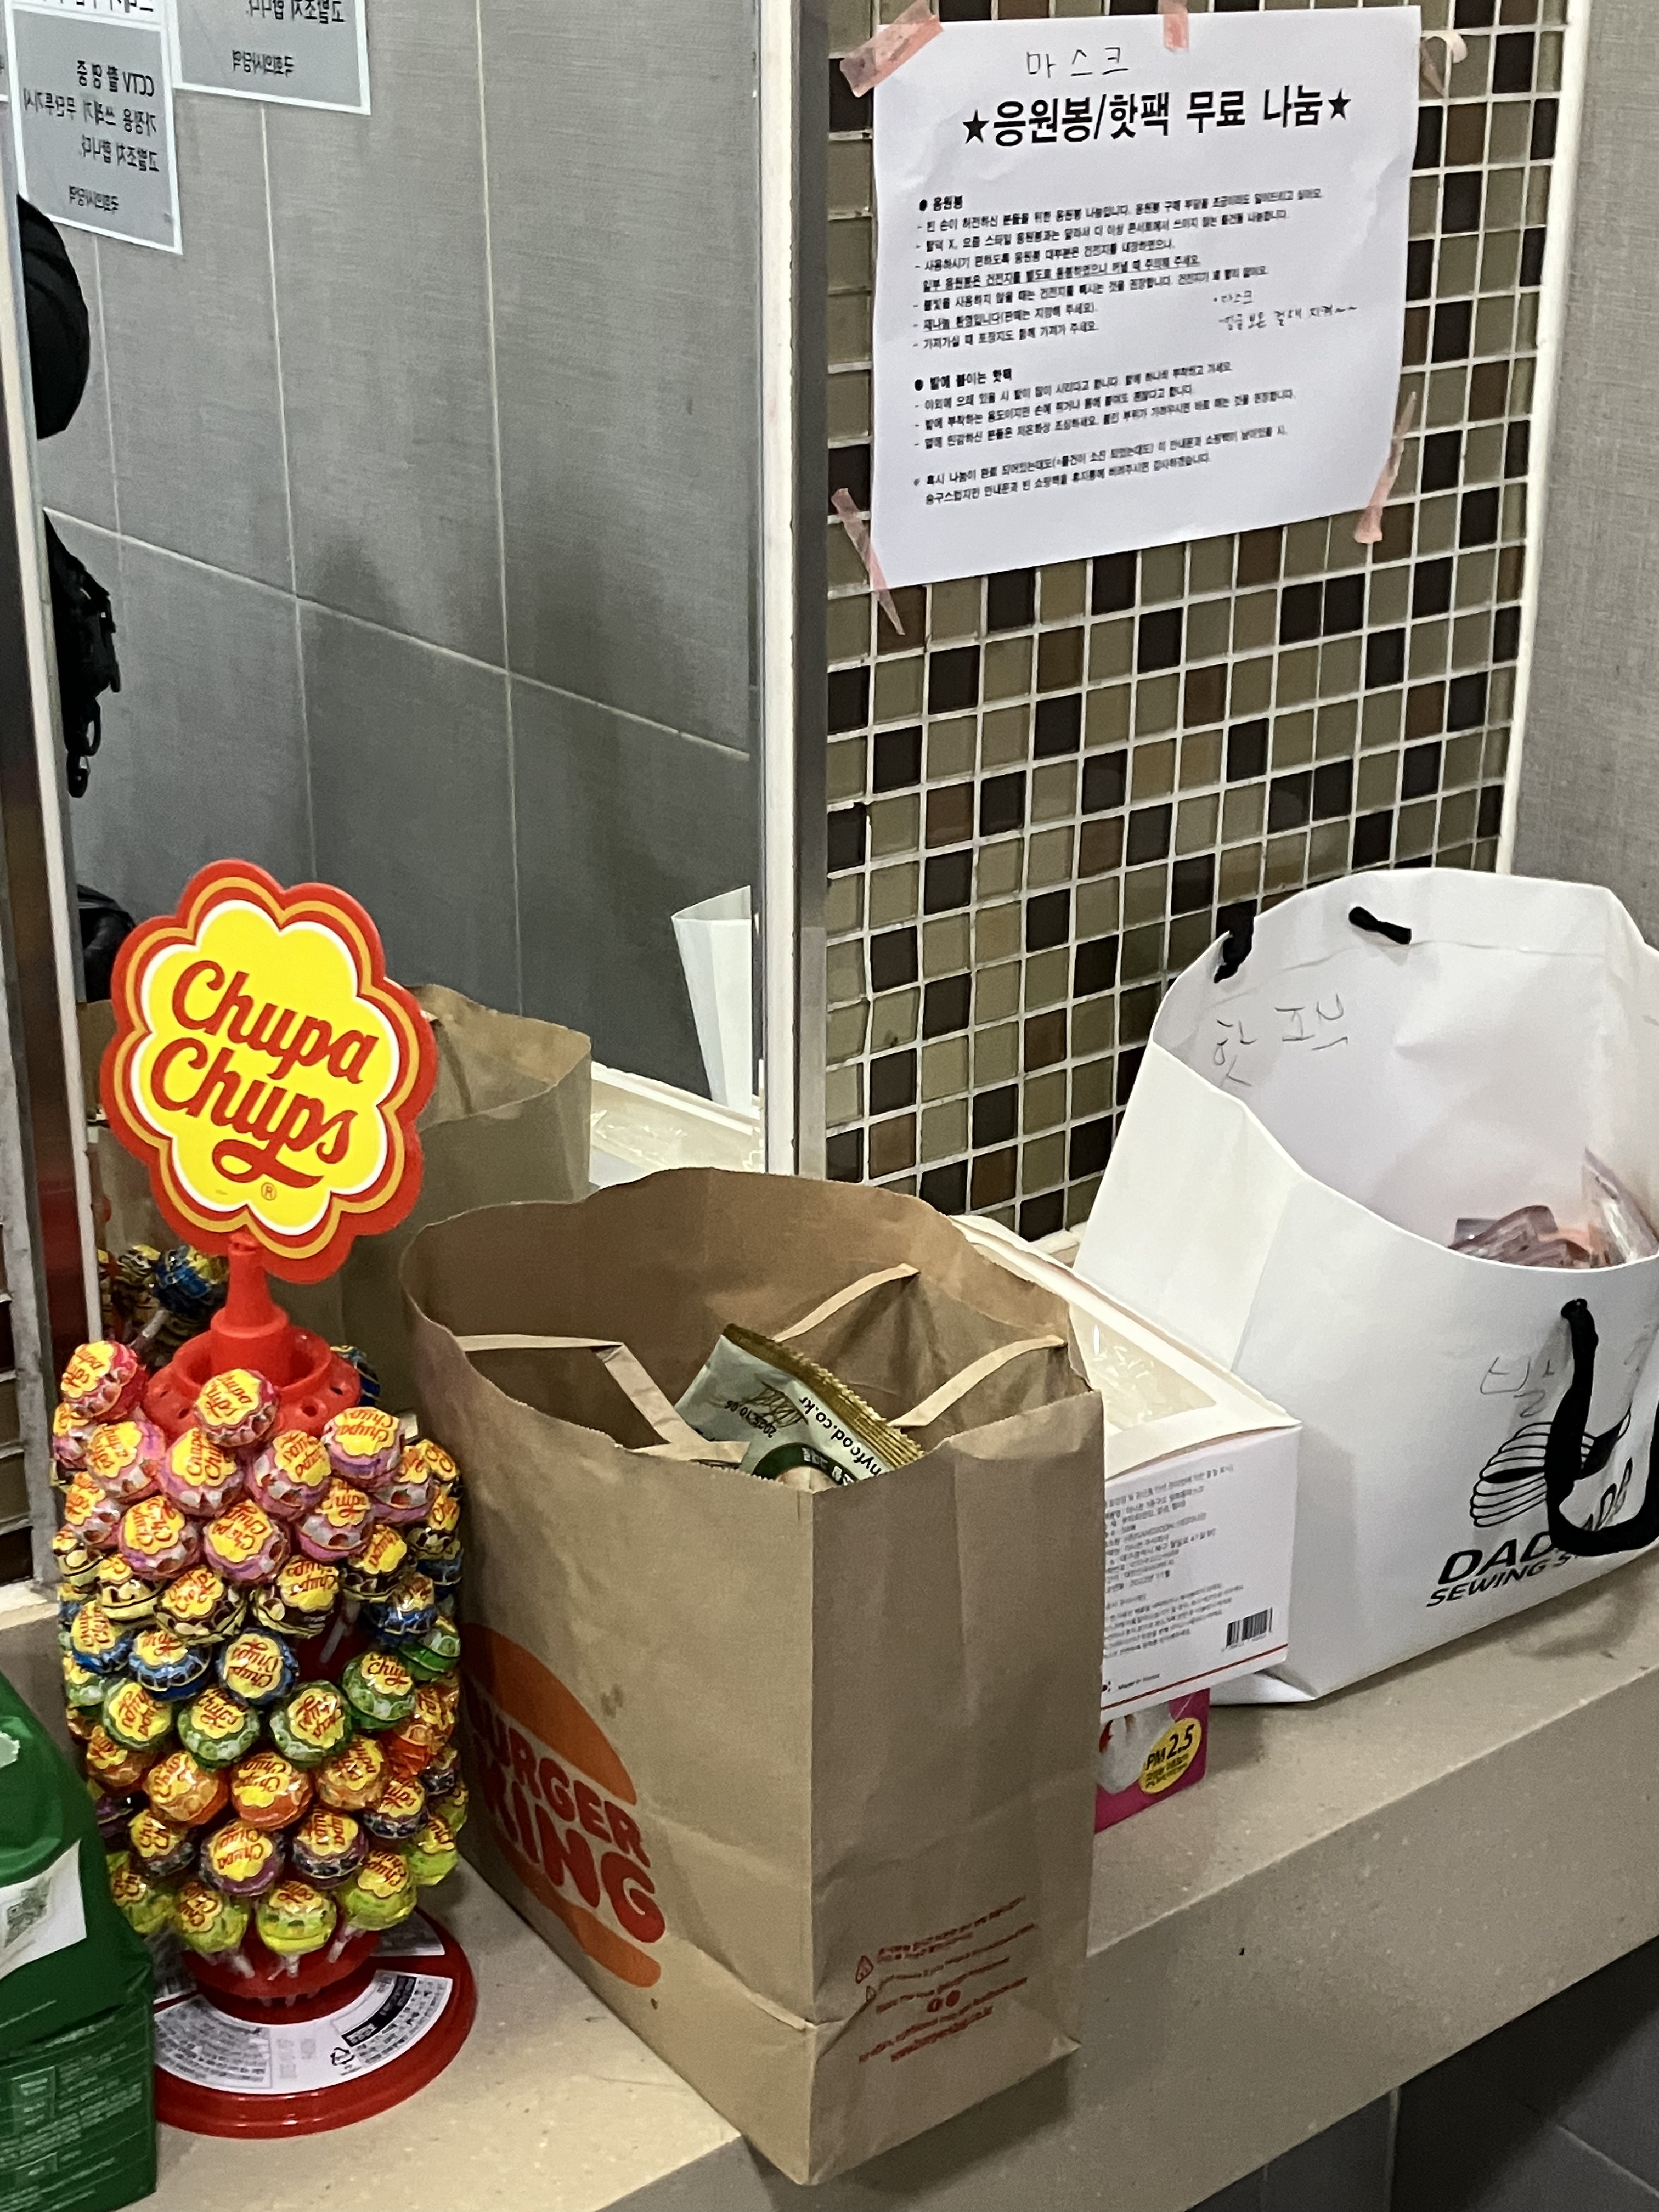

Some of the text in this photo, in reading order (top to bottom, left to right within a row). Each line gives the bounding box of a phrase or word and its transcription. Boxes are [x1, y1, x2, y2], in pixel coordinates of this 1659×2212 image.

[1186, 91, 1246, 133] 무료
[172, 960, 379, 1085] Chupa
[150, 1037, 358, 1188] Chups
[1166, 1724, 1196, 1760] 2.5
[473, 1733, 666, 1943] KING
